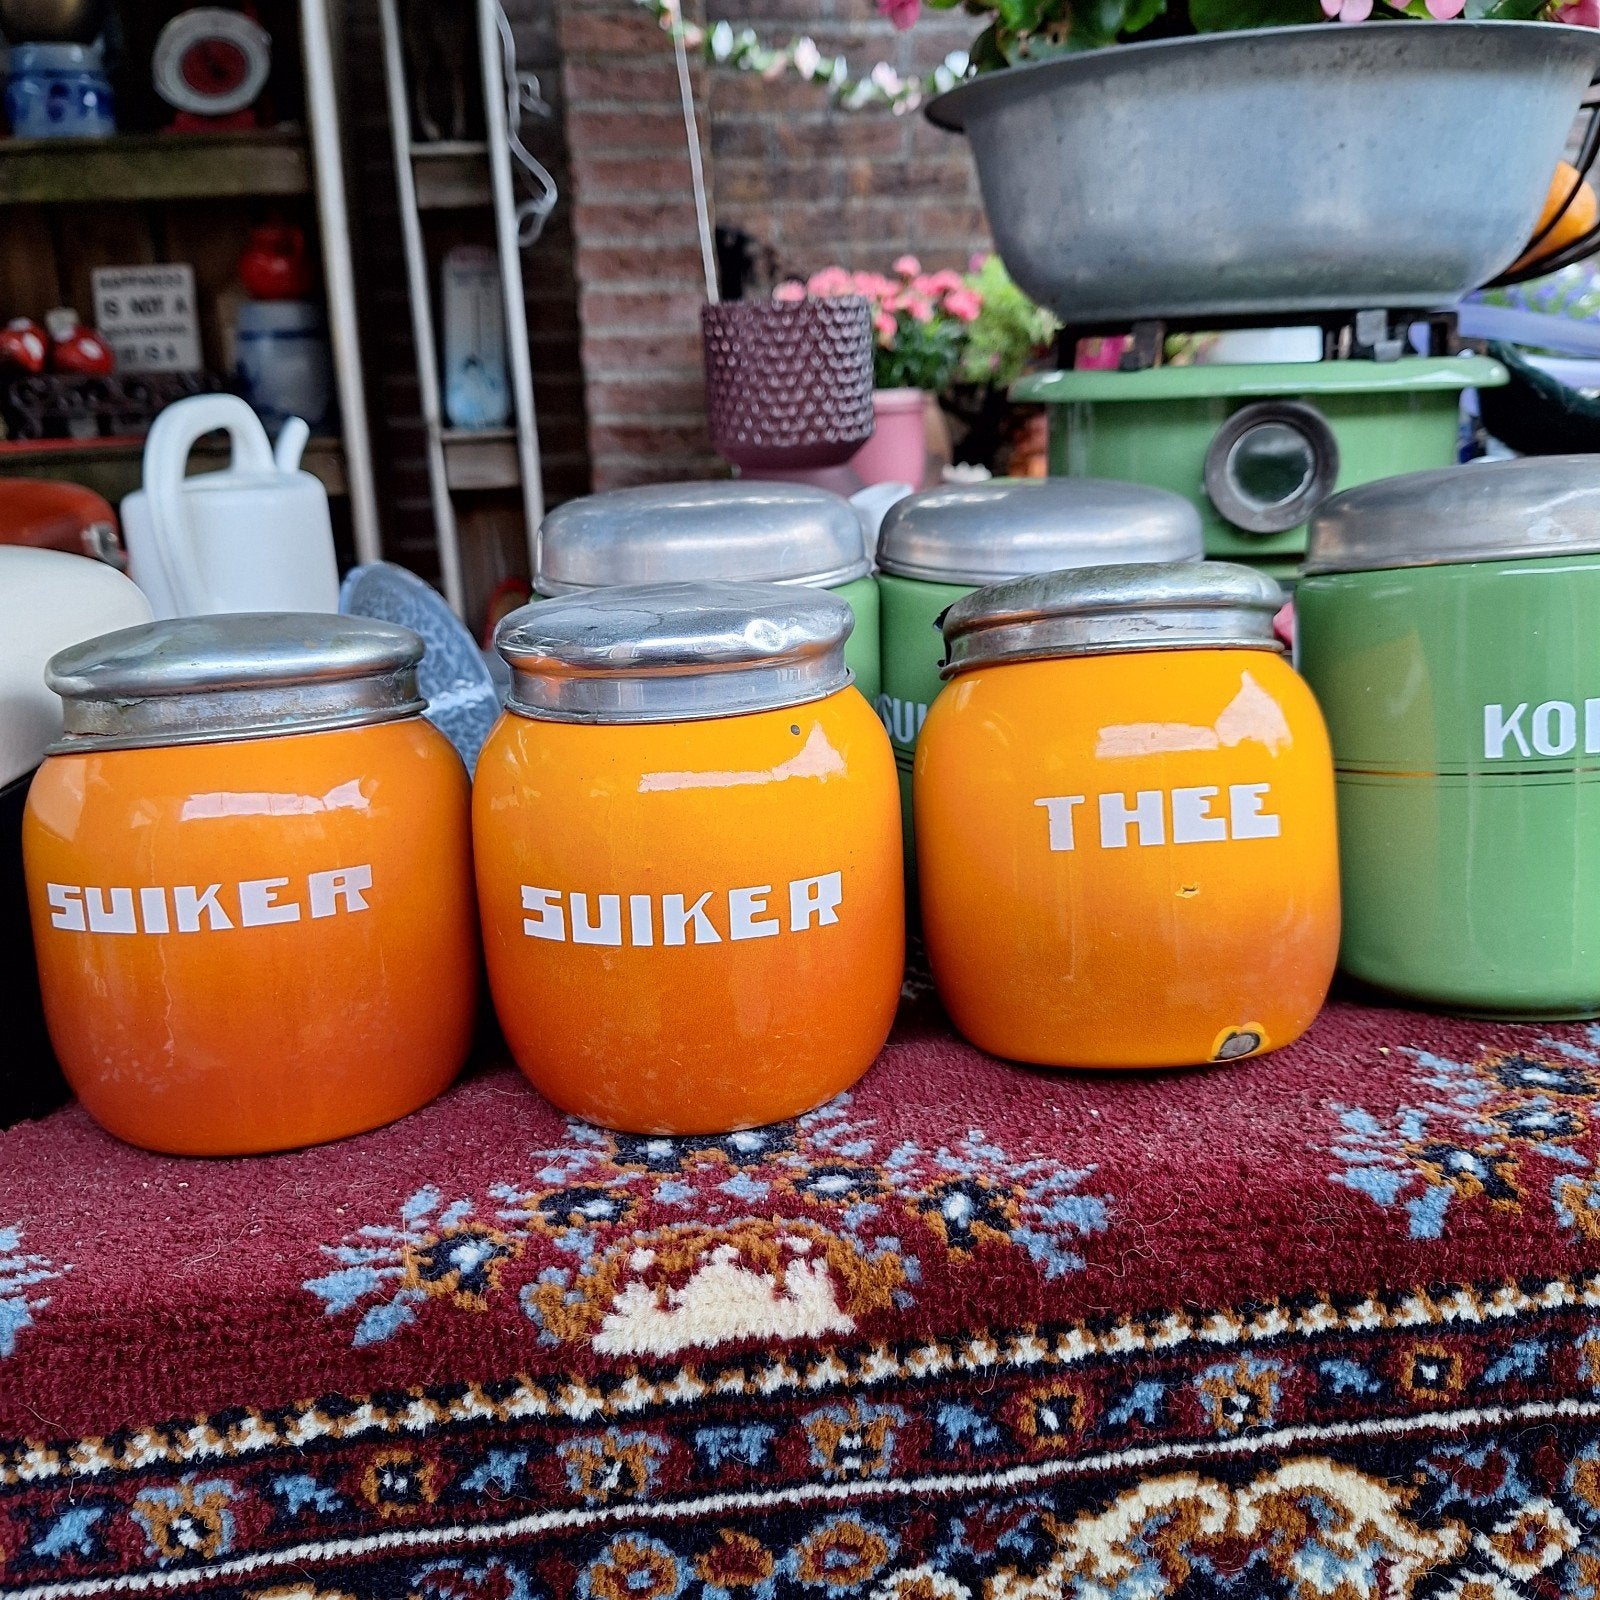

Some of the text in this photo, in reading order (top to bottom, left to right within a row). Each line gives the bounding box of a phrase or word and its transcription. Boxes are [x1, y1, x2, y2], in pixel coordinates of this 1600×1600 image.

[103, 295, 187, 316] IS NOT A
[1034, 783, 1281, 850] THEE
[47, 864, 373, 934] SUIKER
[521, 871, 842, 946] SUIKER
